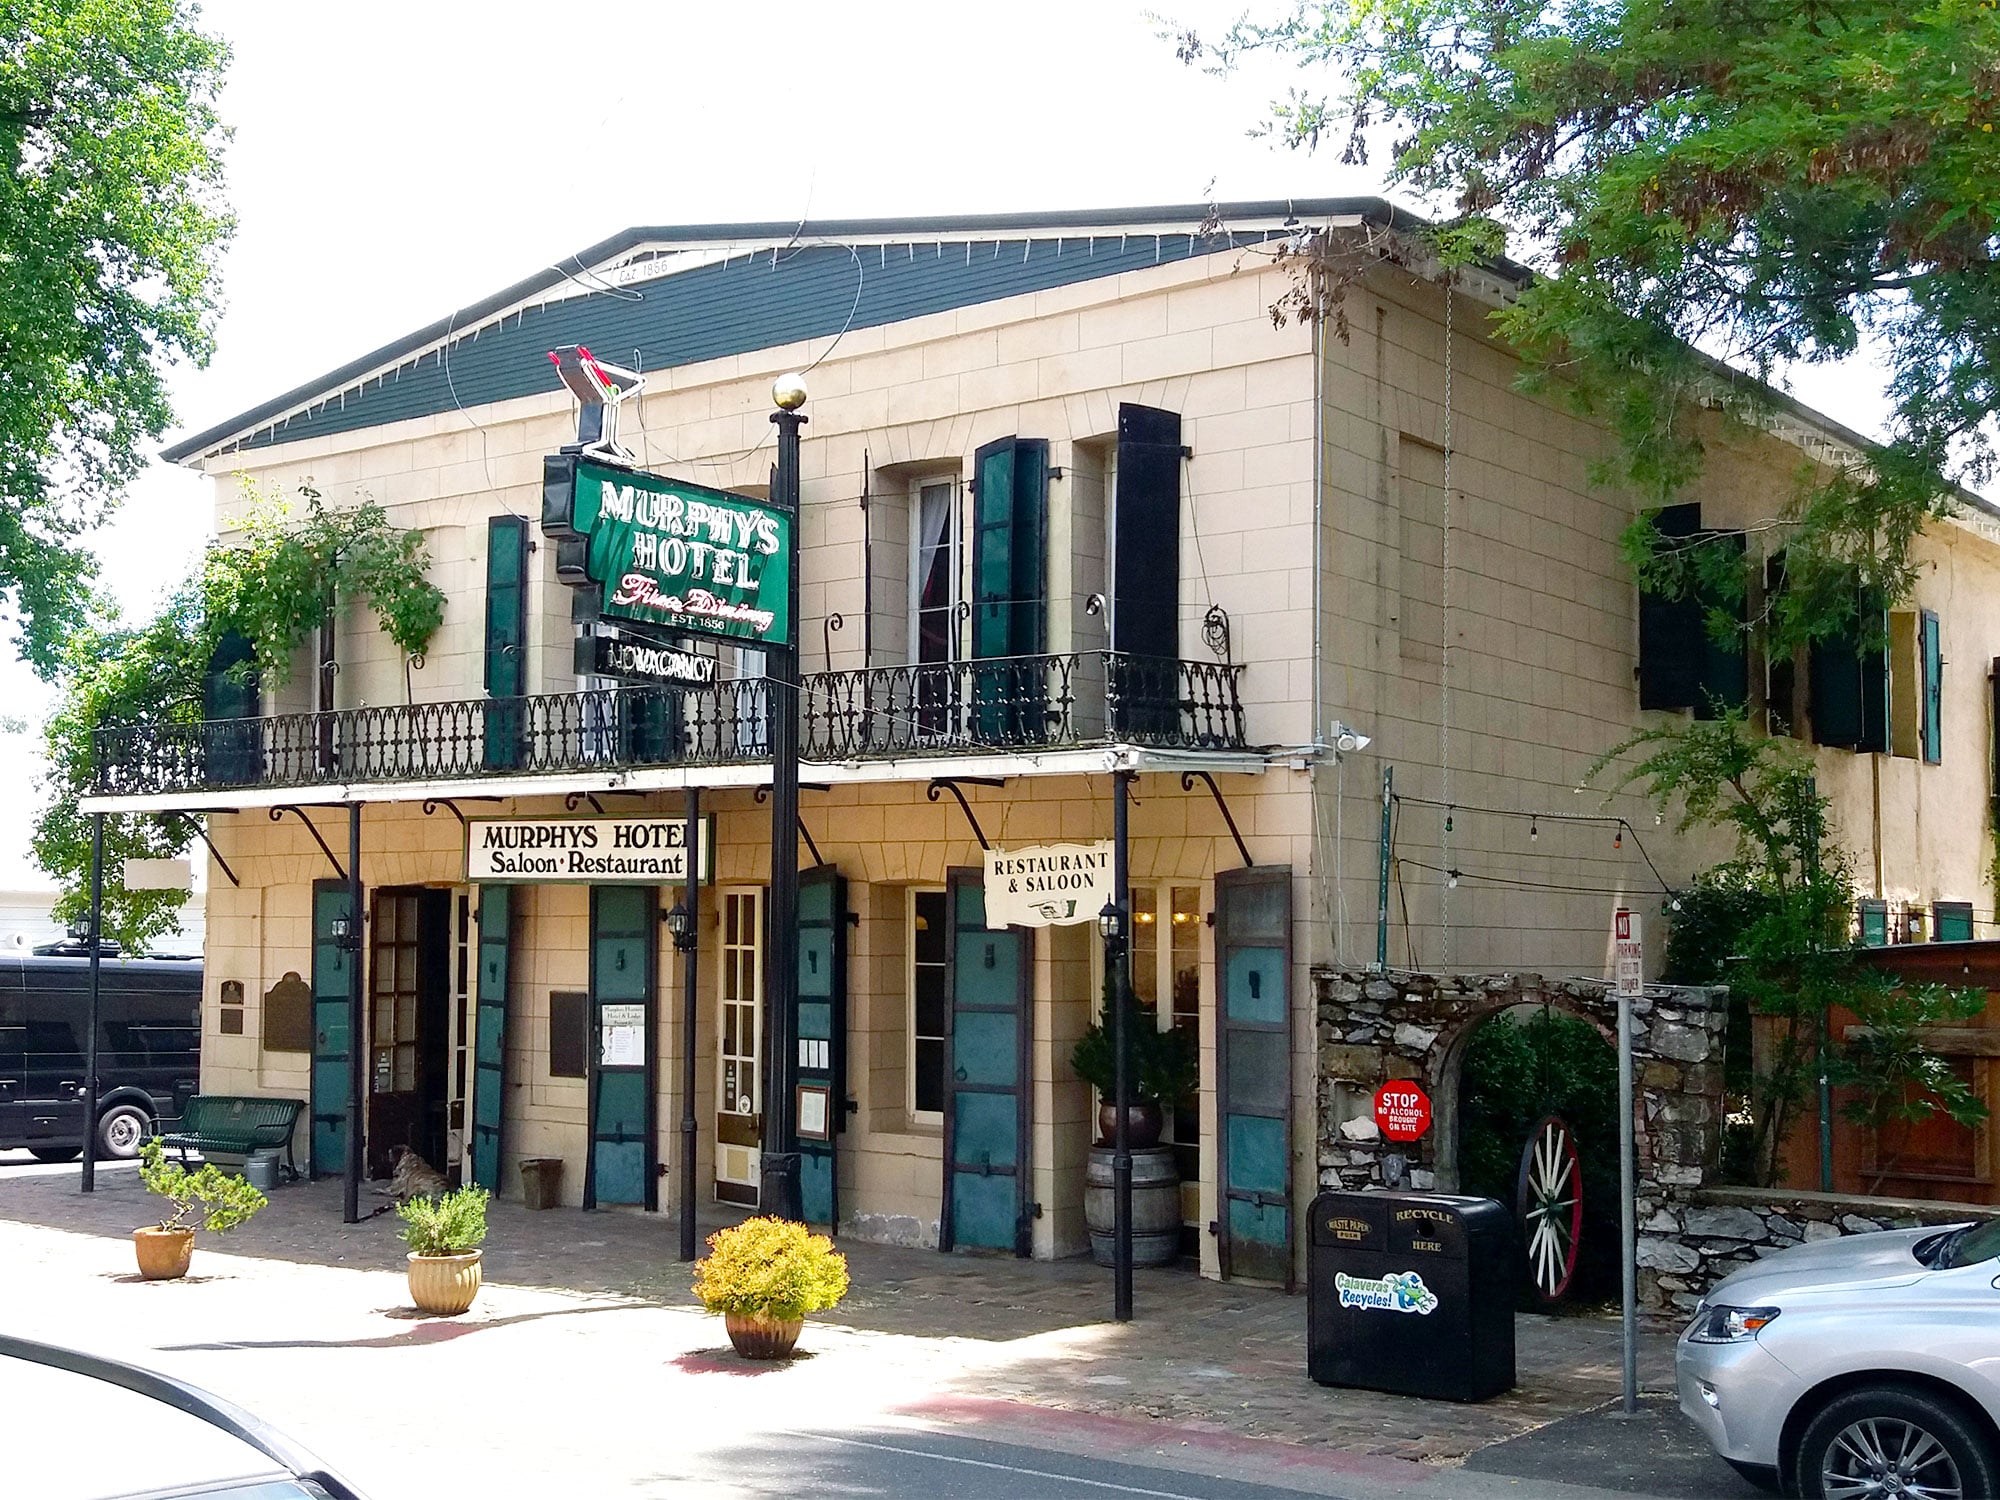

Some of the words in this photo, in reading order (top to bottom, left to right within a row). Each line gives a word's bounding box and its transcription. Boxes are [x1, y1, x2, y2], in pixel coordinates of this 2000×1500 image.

[643, 260, 668, 277] 1856
[631, 531, 759, 590] HOTEL
[610, 573, 684, 613] Fine
[682, 588, 775, 632] Dining
[671, 613, 698, 627] EST.
[700, 617, 725, 631] 1856
[608, 642, 635, 671] NO
[634, 646, 715, 682] VACANCY
[483, 824, 597, 849] MURPHYS
[490, 851, 557, 873] Saloon
[567, 851, 683, 874] Restaurant
[994, 852, 1108, 876] RESTAURANT
[1008, 878, 1019, 893] &
[1026, 873, 1095, 892] SALOON
[1617, 916, 1628, 936] NO
[1383, 1093, 1418, 1108] STOP
[1378, 1107, 1388, 1115] NO
[1390, 1107, 1424, 1118] ALCOHOL
[1389, 1116, 1417, 1124] BROUGHT
[1389, 1123, 1400, 1131] ON
[1401, 1124, 1417, 1132] SITE
[1396, 1208, 1454, 1224] RECYCLE
[1328, 1219, 1349, 1231] WASTE
[1349, 1219, 1370, 1233] PAPER
[1339, 1231, 1359, 1239] PUSH
[1412, 1240, 1442, 1252] HERE
[1337, 1274, 1389, 1294] Calaveras
[1342, 1289, 1392, 1309] Recycles!
